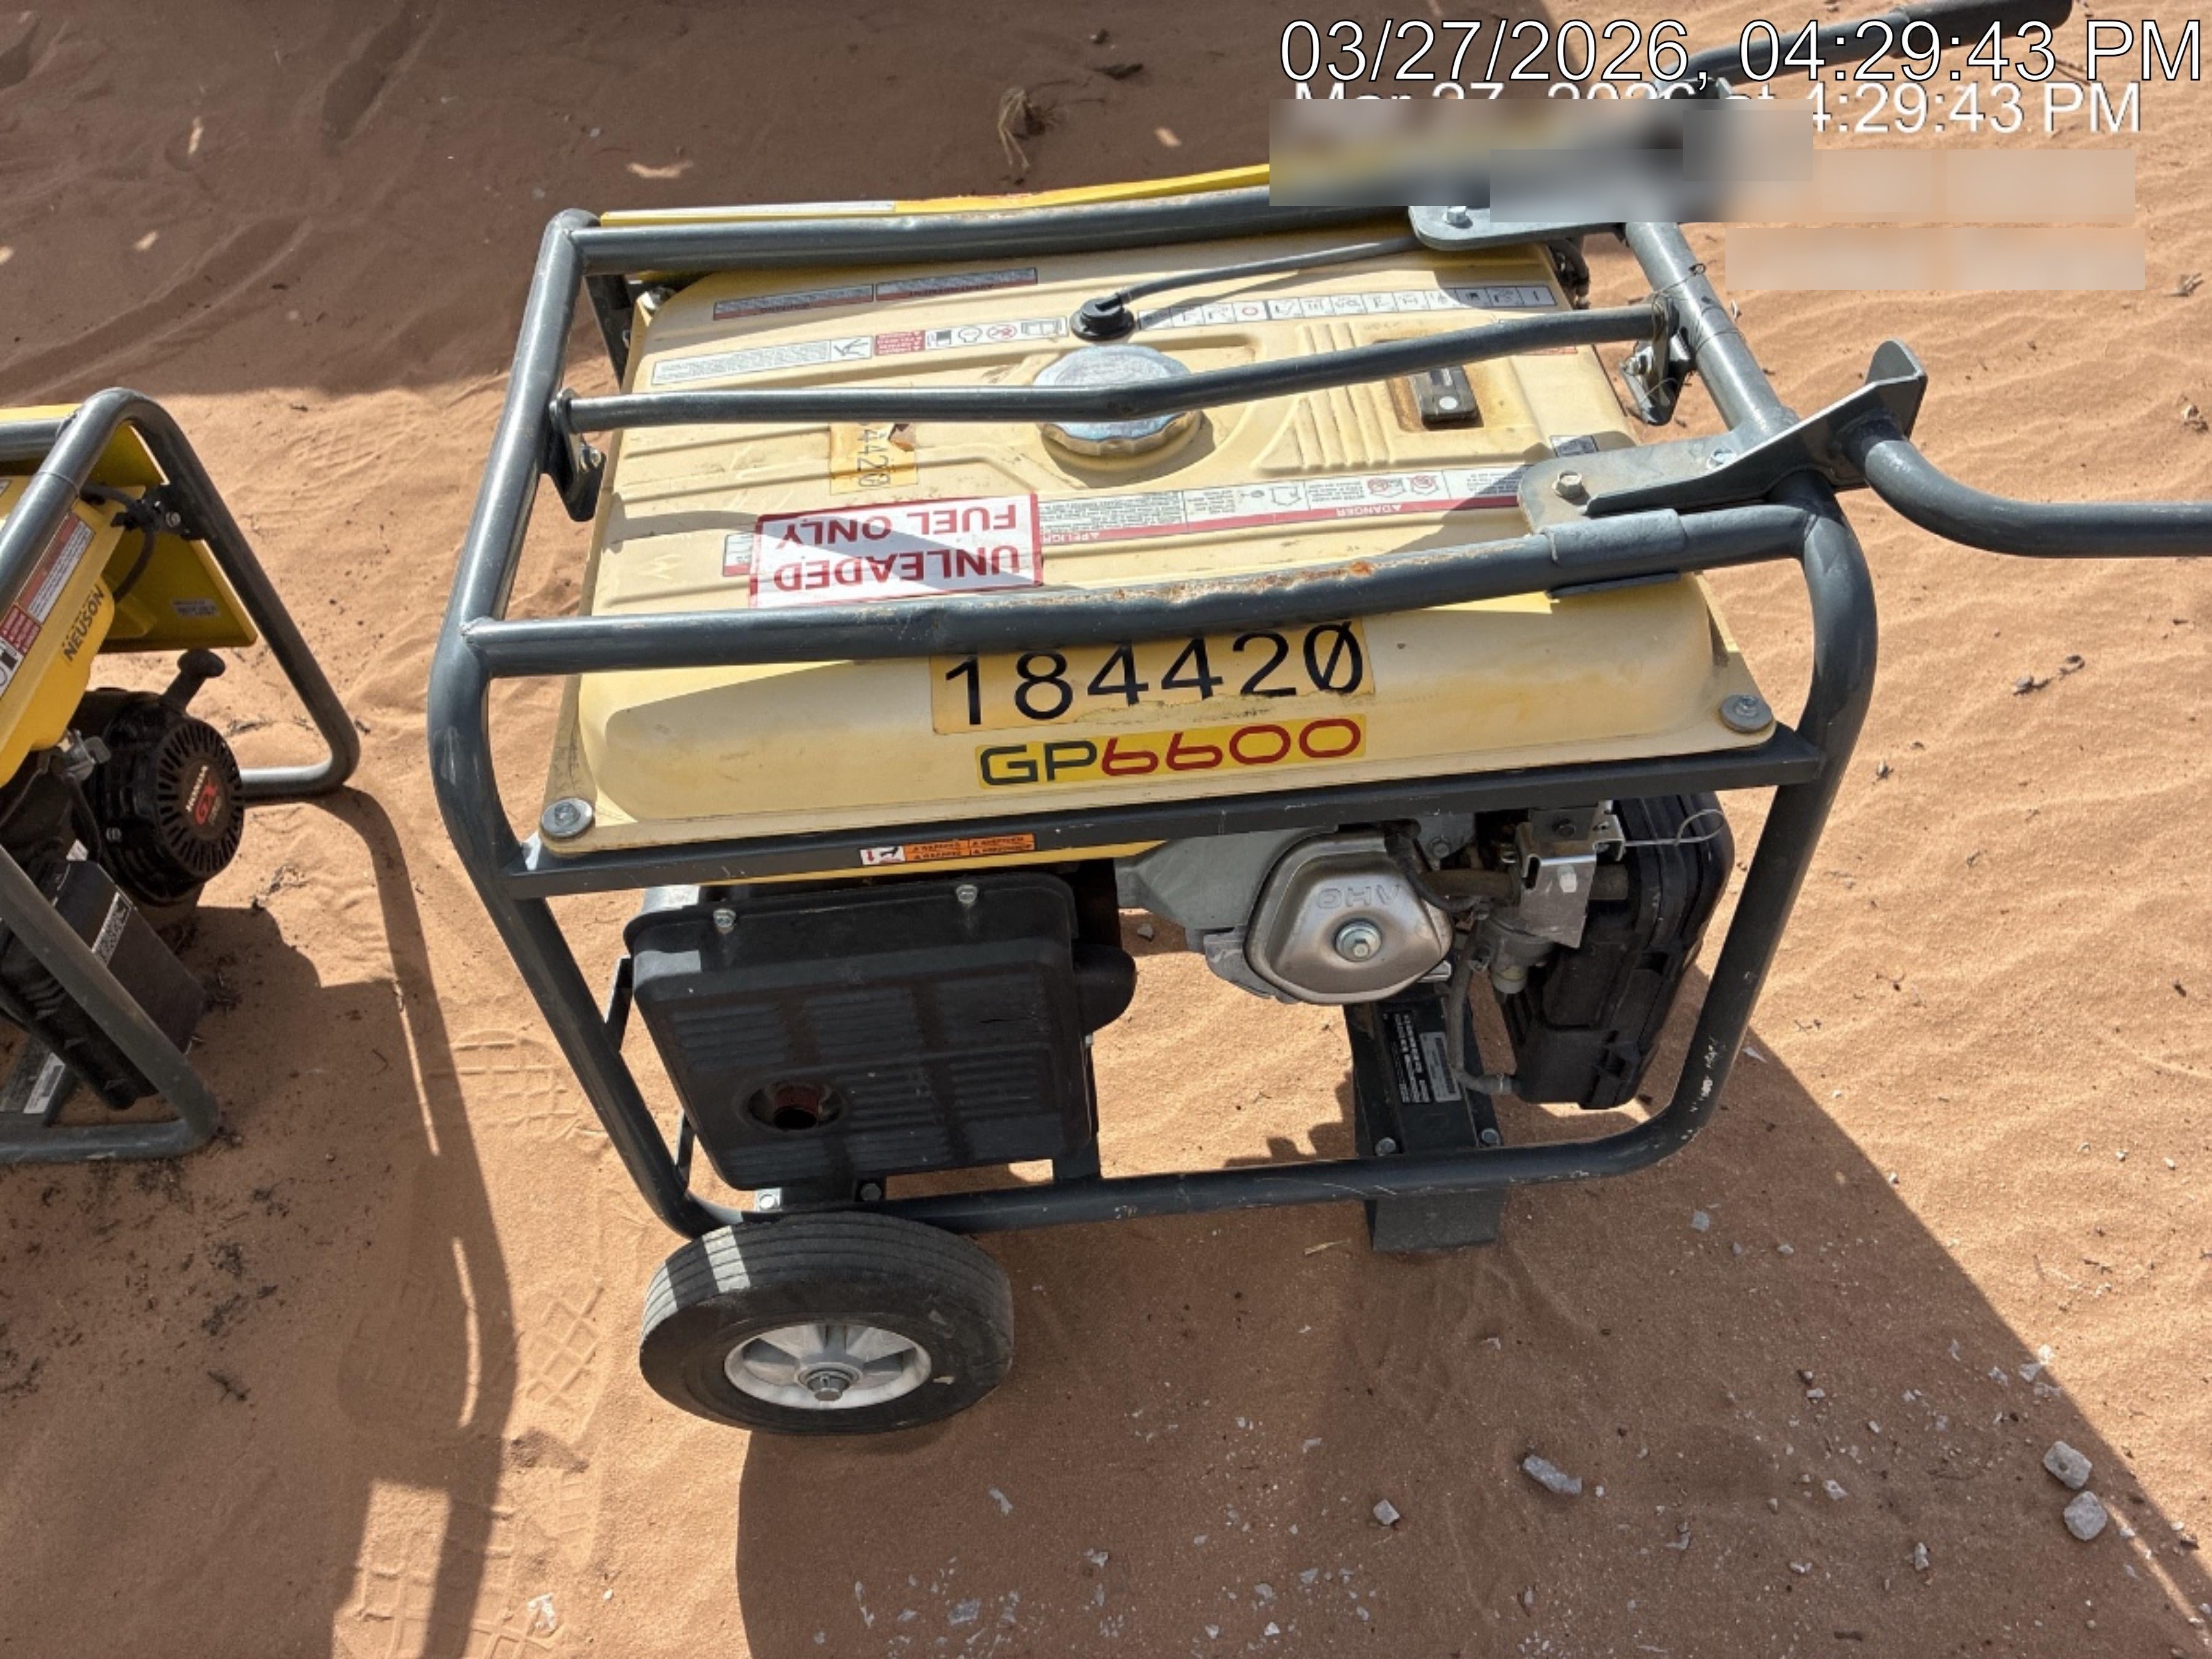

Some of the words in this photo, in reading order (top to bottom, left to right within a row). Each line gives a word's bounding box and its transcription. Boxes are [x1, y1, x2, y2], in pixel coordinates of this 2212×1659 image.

[857, 422, 891, 487] 4420
[906, 504, 1017, 535] FUEL
[1336, 504, 1390, 517] DANGER
[775, 514, 893, 551] ONLY
[1042, 532, 1089, 544] PELIGR
[772, 544, 1020, 592] UNLEADED
[63, 584, 104, 662] NEUSON
[944, 621, 1363, 725] 184420
[980, 717, 1362, 786] GP6600
[1316, 883, 1400, 909] OHV
